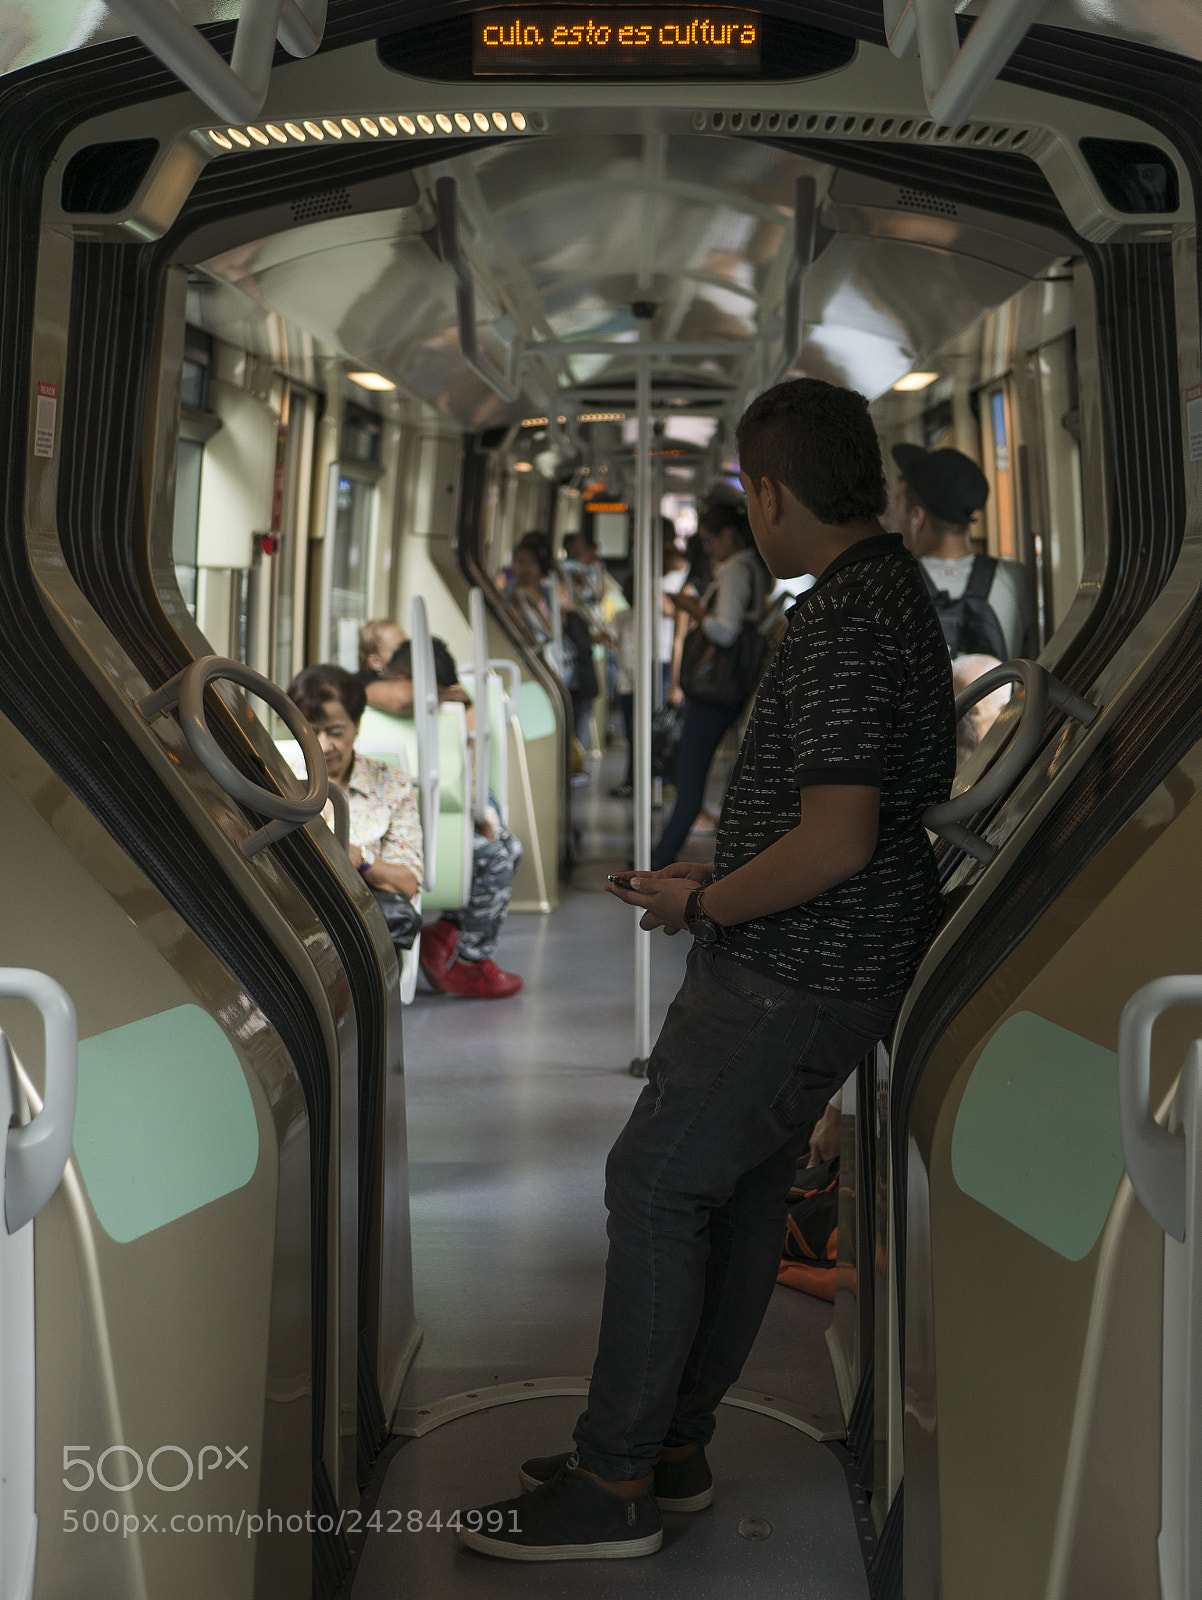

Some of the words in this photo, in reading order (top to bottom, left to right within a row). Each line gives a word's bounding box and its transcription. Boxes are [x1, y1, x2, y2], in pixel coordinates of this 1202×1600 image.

[551, 20, 611, 46] esto
[618, 25, 652, 46] es
[659, 19, 756, 45] cultura
